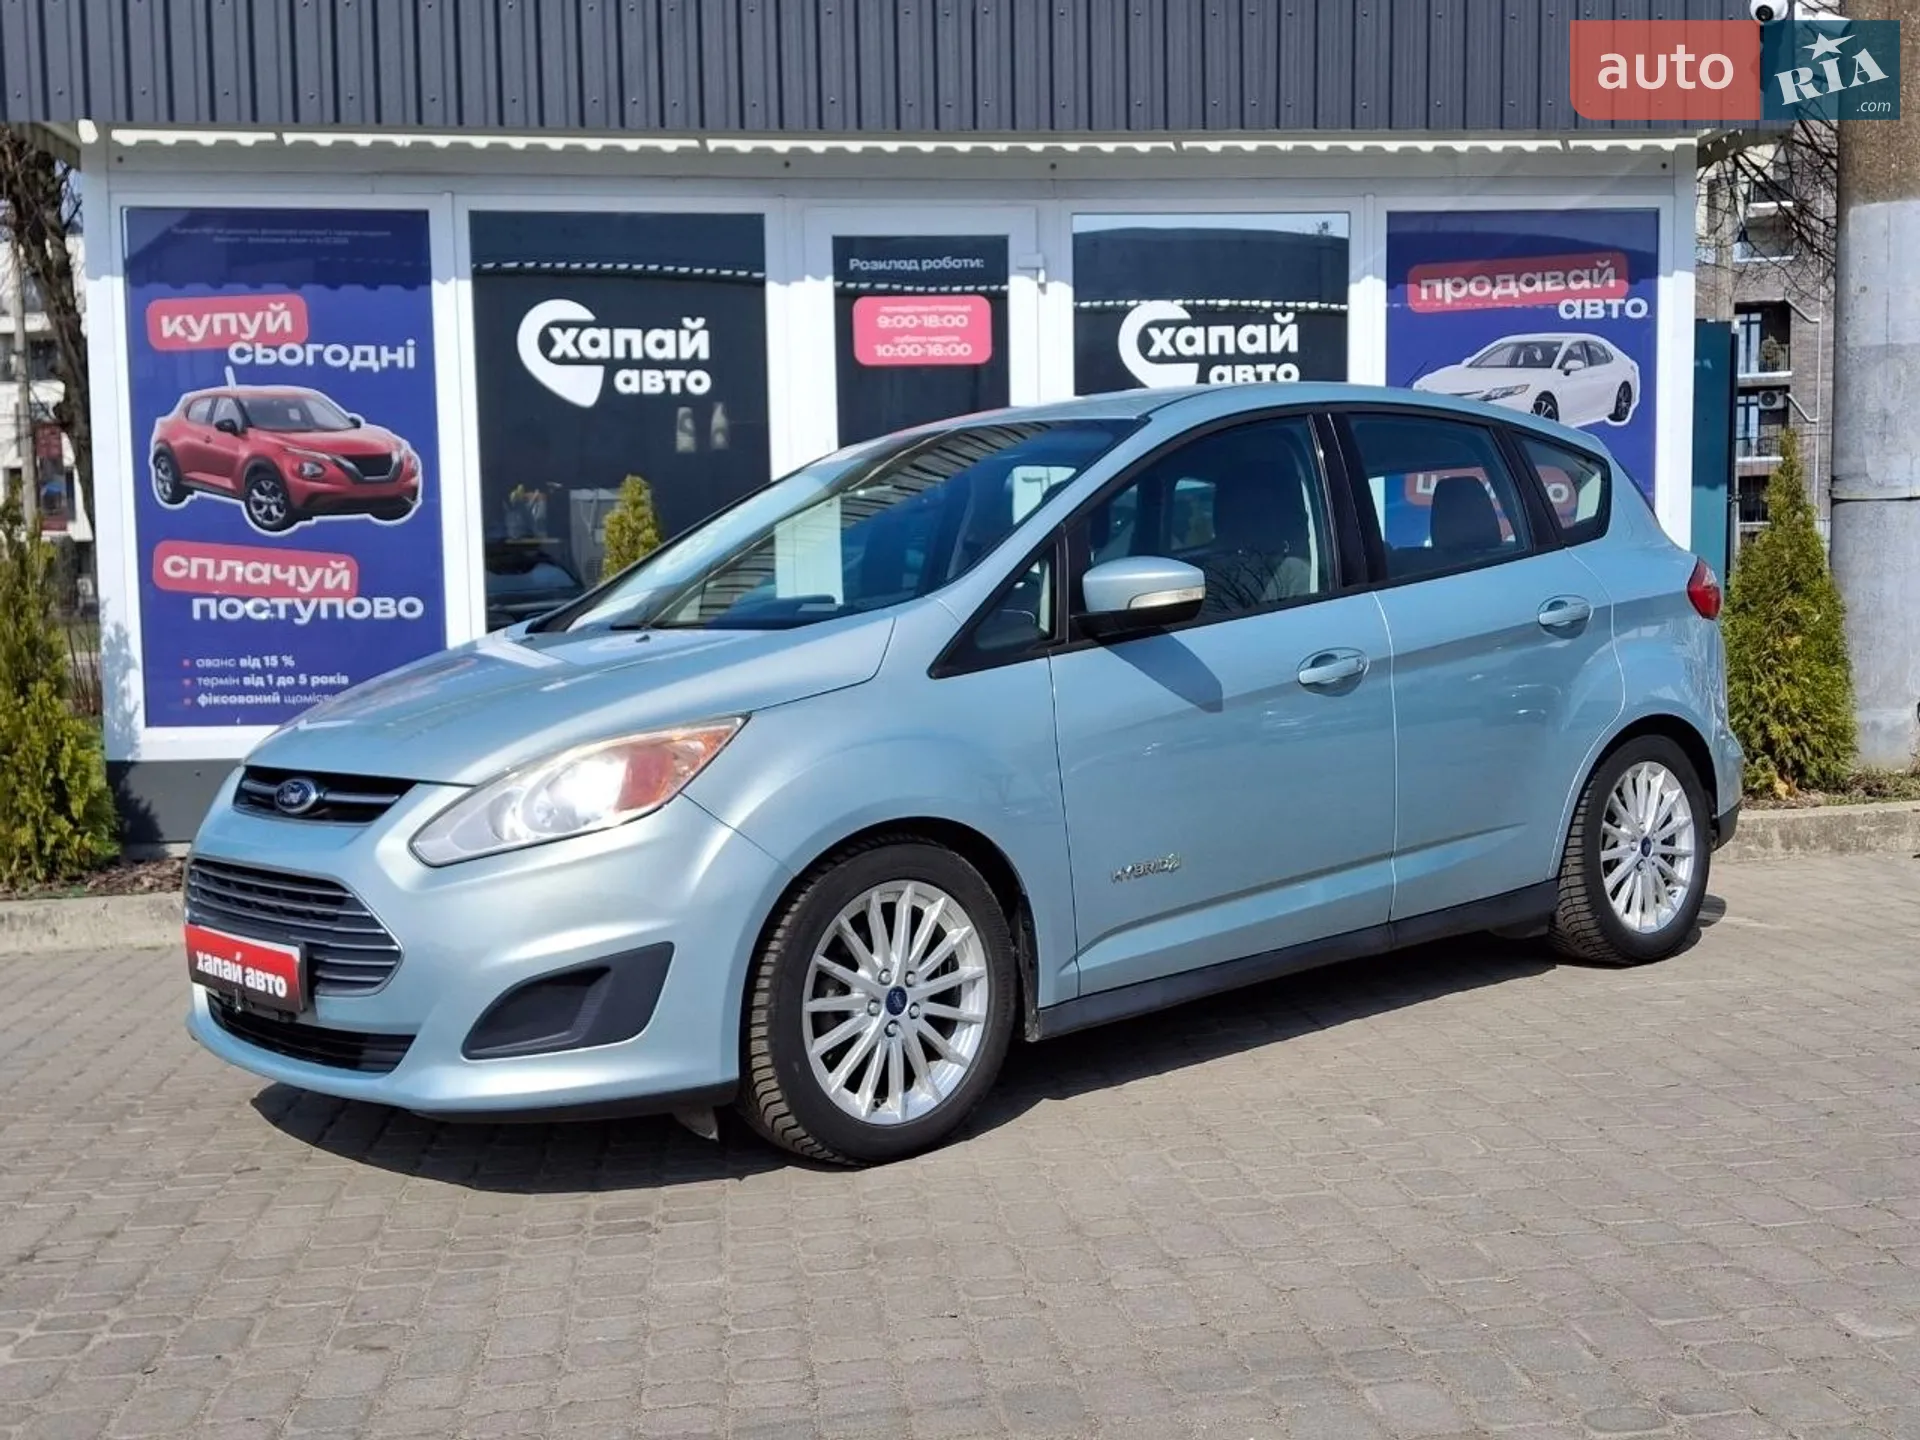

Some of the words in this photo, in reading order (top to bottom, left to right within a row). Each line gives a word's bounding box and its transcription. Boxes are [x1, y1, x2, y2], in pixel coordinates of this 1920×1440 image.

[850, 258, 919, 271] Розклад
[921, 257, 985, 271] роботи:
[1420, 260, 1616, 304] продавай
[1558, 297, 1649, 320] авто
[160, 302, 292, 342] купуй
[876, 314, 969, 329] 9:00-18:00
[227, 338, 416, 372] сьогодні
[613, 368, 712, 395] авто
[1208, 363, 1300, 385] авто
[162, 554, 350, 593] сплачуй
[192, 596, 425, 626] поступово
[196, 658, 237, 668] аванс
[239, 655, 261, 670] від
[263, 655, 279, 667] 15
[281, 656, 295, 667] %
[197, 675, 240, 689] термін
[243, 675, 265, 687] від
[266, 674, 274, 686] 1
[276, 676, 295, 688] до
[298, 674, 308, 686] 5
[310, 673, 349, 687] років
[197, 692, 281, 708] фіксований
[196, 951, 243, 984] хапай
[244, 966, 287, 998] авто
